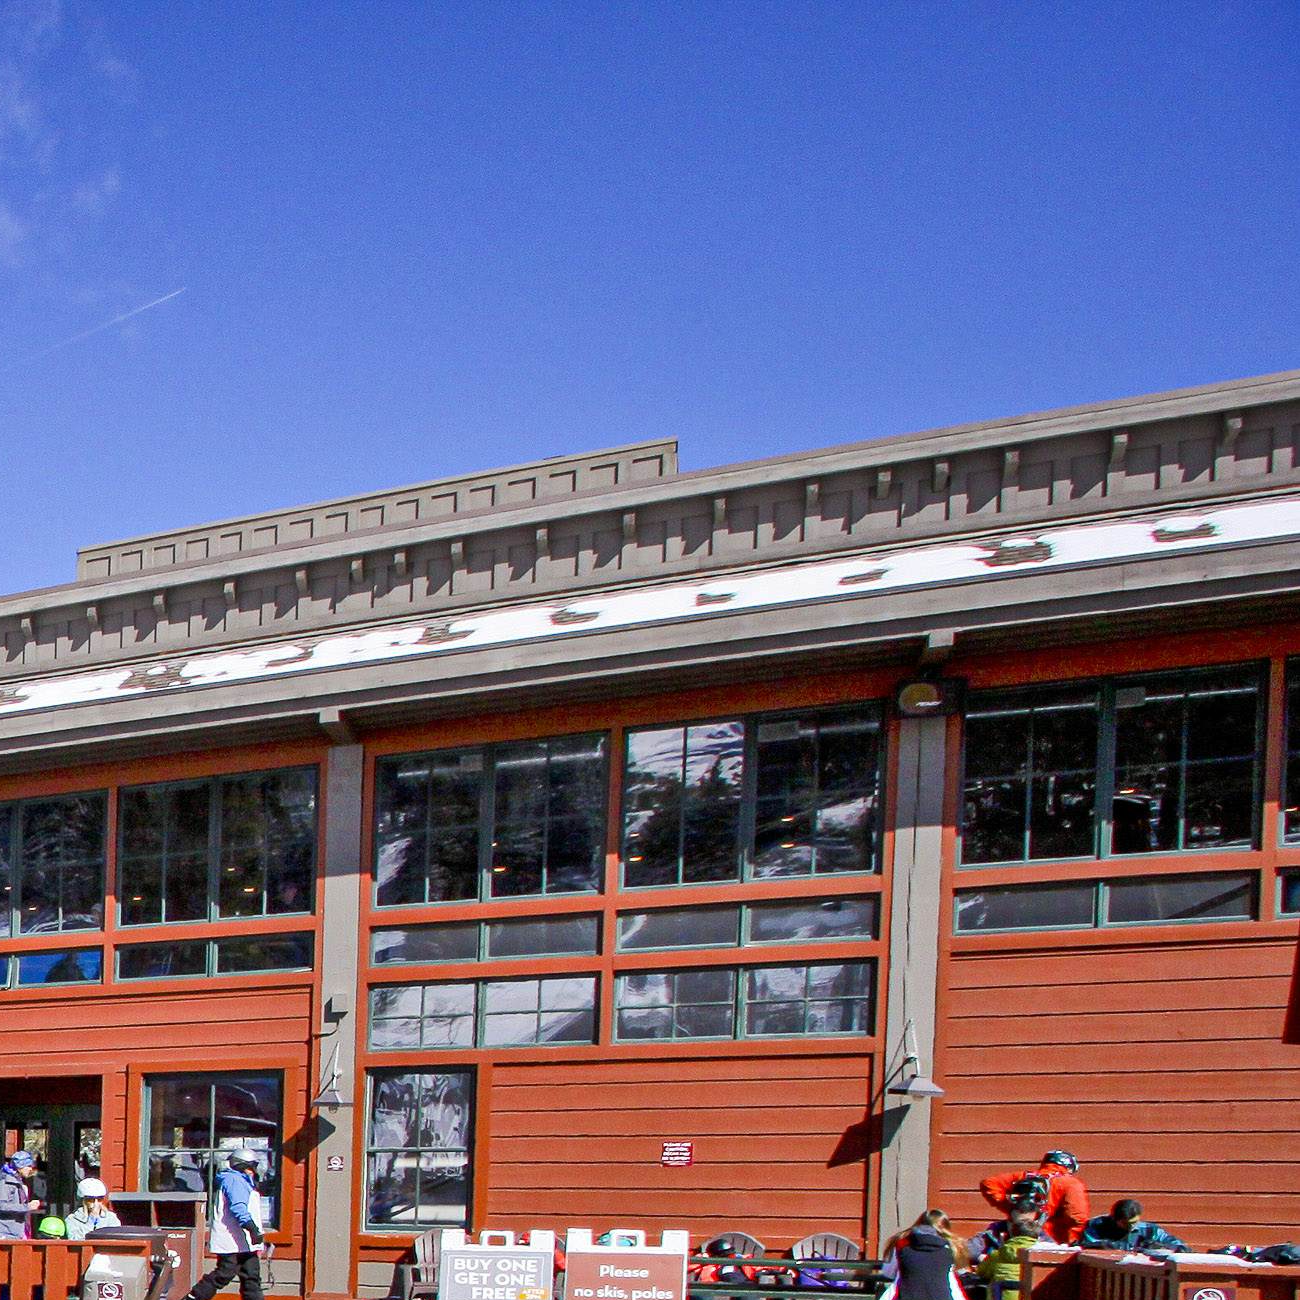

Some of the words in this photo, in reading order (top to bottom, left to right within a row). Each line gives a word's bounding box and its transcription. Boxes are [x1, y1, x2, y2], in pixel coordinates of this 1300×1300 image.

[454, 1258, 493, 1271] BUY
[496, 1259, 538, 1272] ONE
[599, 1264, 649, 1278] Please
[454, 1271, 491, 1285] GET
[494, 1273, 536, 1286] ONE
[471, 1286, 517, 1300] FREE
[574, 1287, 594, 1298] no
[596, 1284, 628, 1299] skis,
[631, 1286, 674, 1300] poles
